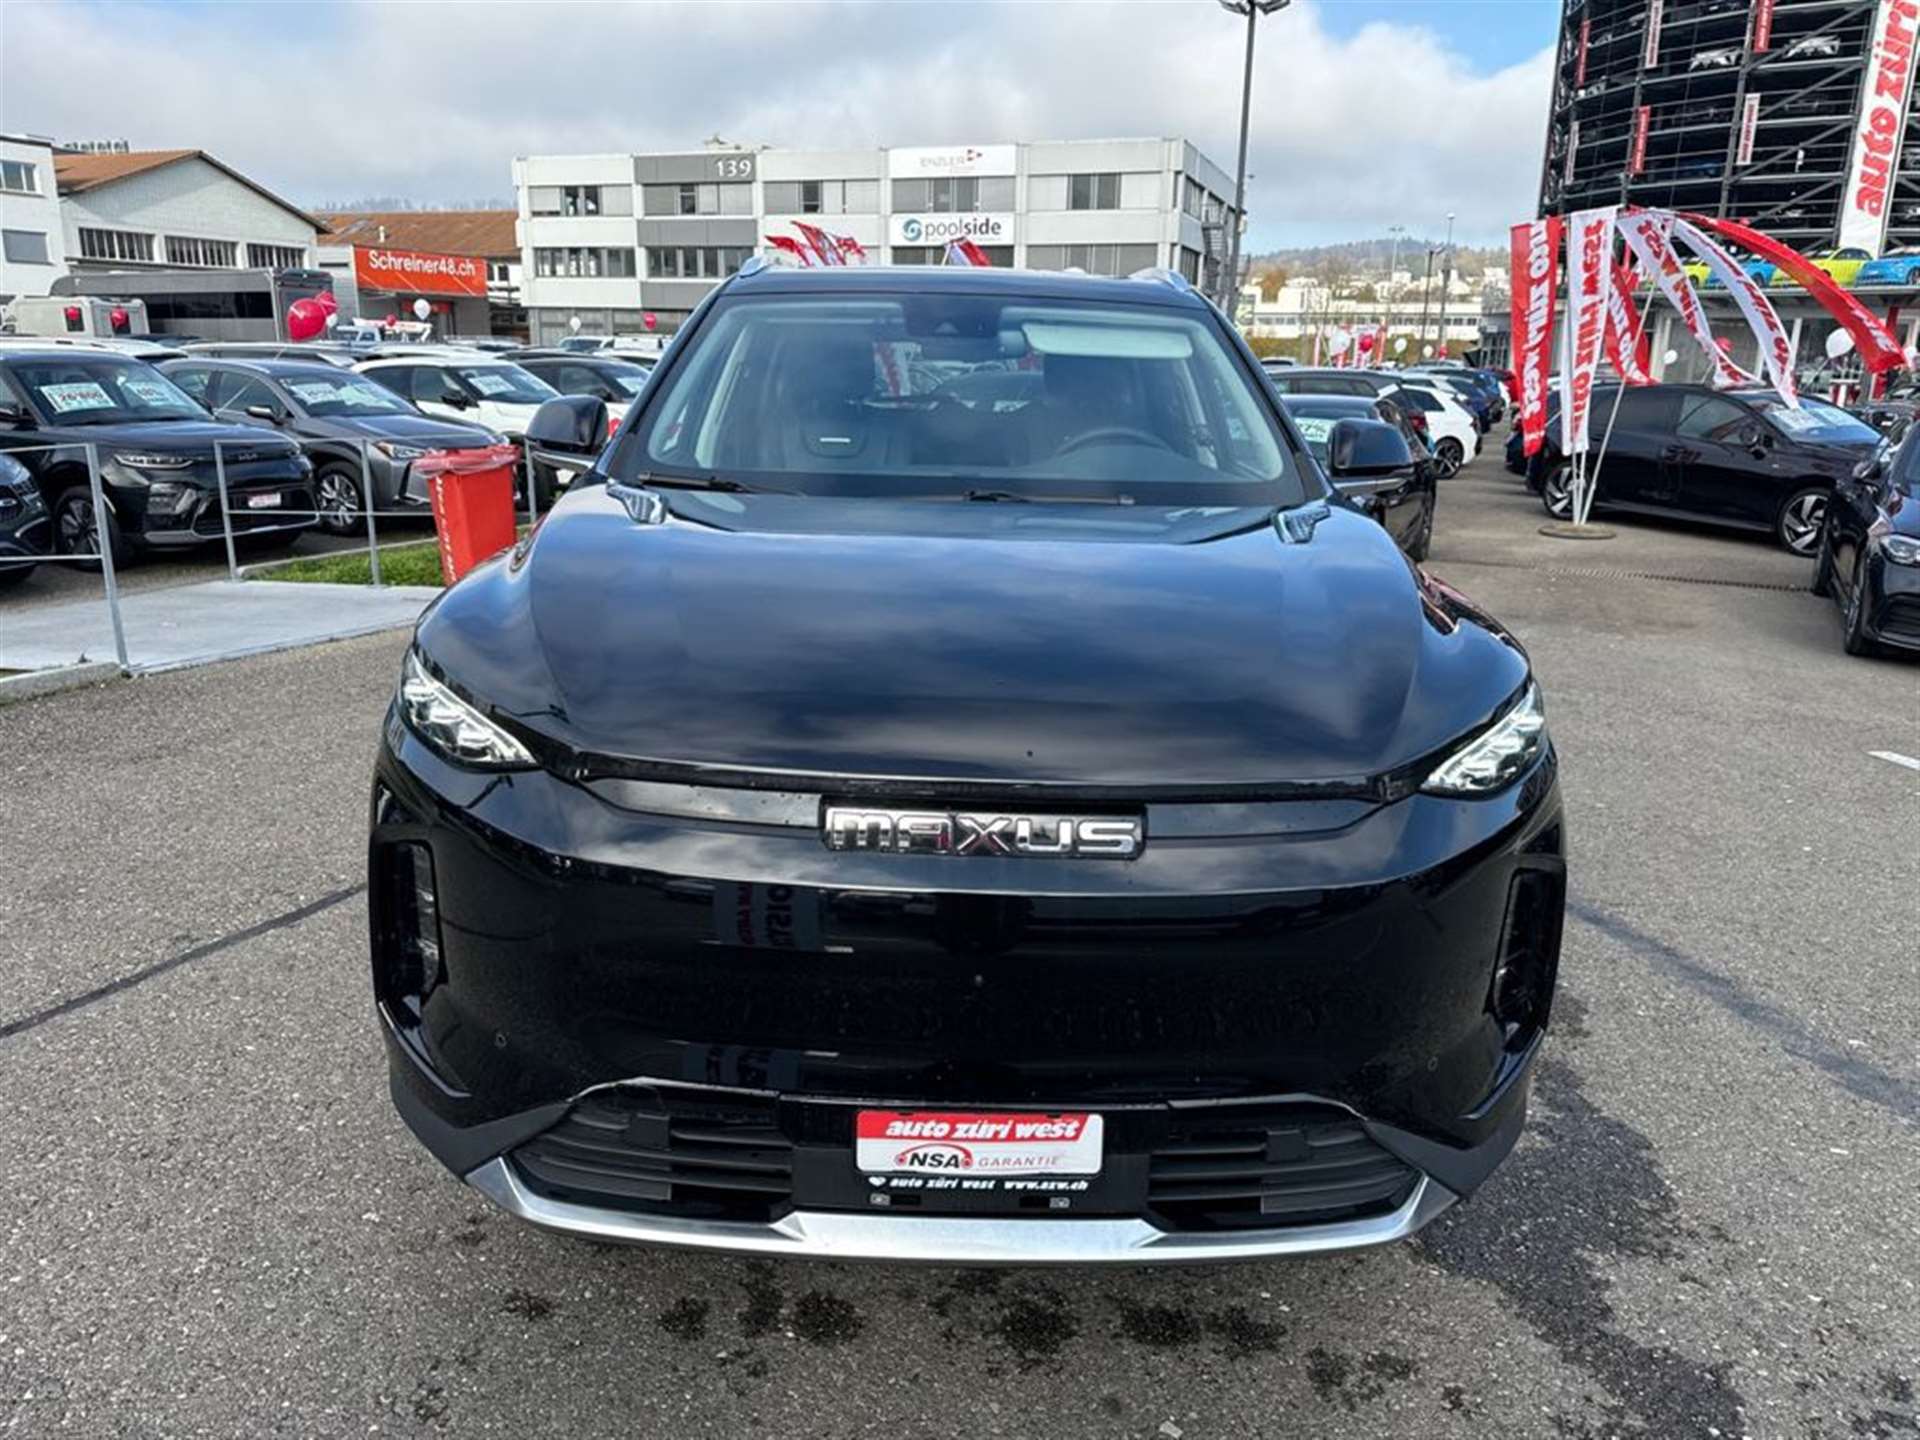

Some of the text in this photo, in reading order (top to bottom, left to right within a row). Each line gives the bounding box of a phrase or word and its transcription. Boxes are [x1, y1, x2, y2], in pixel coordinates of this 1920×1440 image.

[717, 159, 752, 177] 139
[1855, 106, 1897, 217] auto
[925, 217, 1001, 242] poolside
[368, 249, 476, 277] Schreiner48.ch
[829, 808, 1137, 855] MAXUS
[886, 1118, 1080, 1139] auto züri west
[909, 1153, 1059, 1168] NSA GARANTIE
[890, 1178, 923, 1188] auto
[962, 1179, 995, 1190] west
